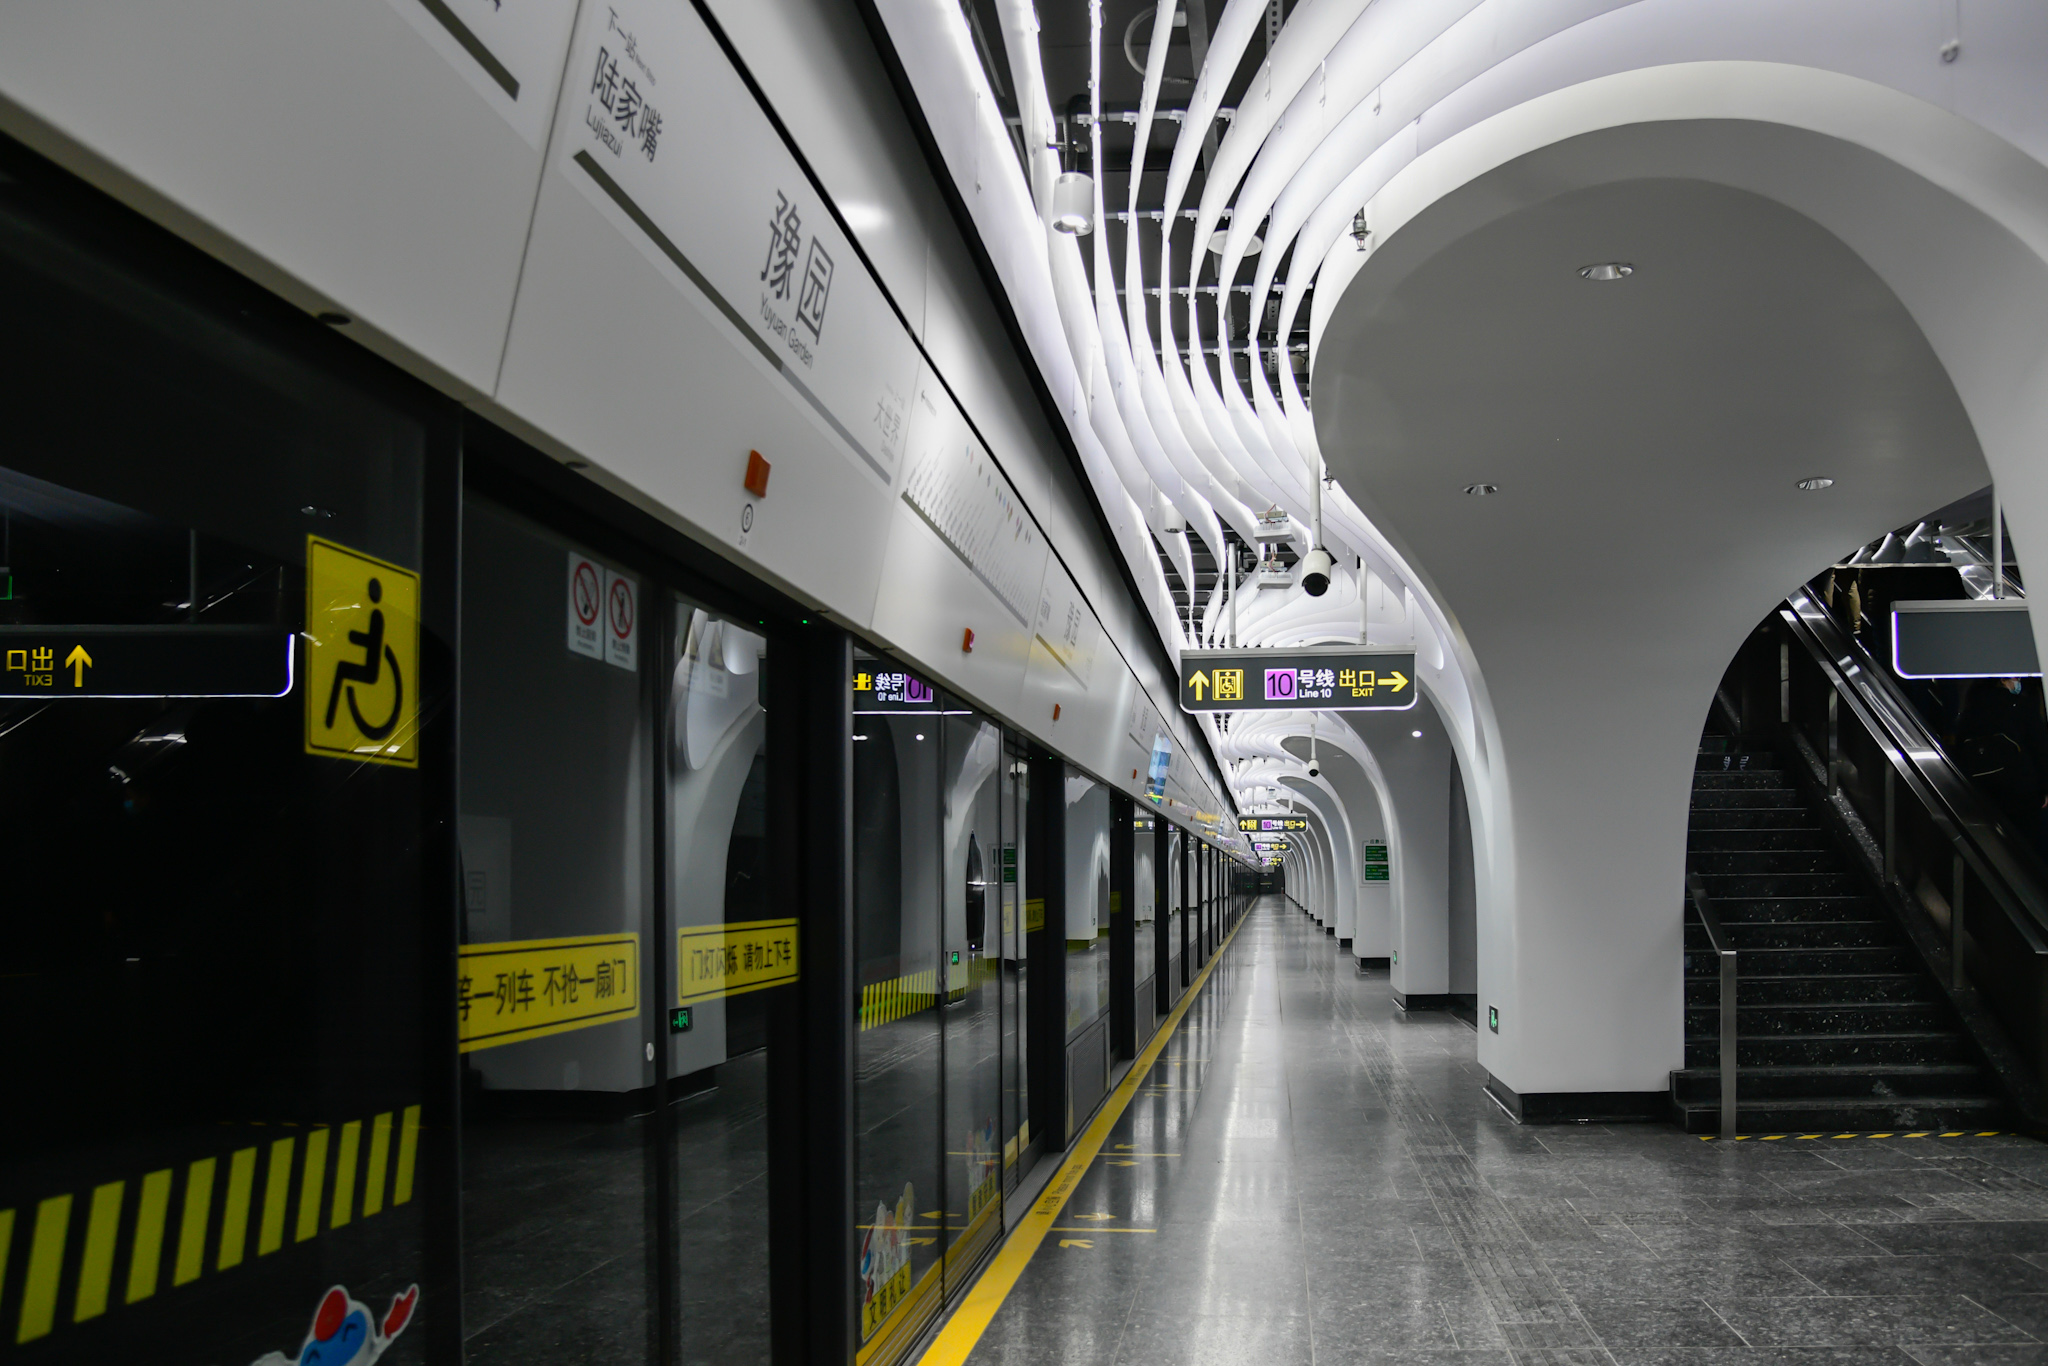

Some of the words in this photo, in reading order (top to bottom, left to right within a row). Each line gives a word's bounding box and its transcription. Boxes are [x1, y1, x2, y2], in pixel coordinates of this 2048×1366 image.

[608, 6, 637, 61] 下一站
[591, 46, 663, 163] 陆家嘴
[586, 104, 623, 158] Lujiazui
[760, 188, 834, 346] 豫园
[759, 292, 787, 341] Yuyuan
[788, 326, 814, 370] Garden
[1267, 673, 1293, 697] 10
[1298, 669, 1335, 688] 号线
[1339, 669, 1375, 688] 出口
[1299, 689, 1318, 698] Line
[1320, 688, 1332, 698] 10
[1352, 688, 1375, 697] EXIT
[543, 959, 627, 1007] 不抢一扇门
[691, 944, 738, 981] 门灯闪烁
[743, 938, 792, 971] 请勿上下车
